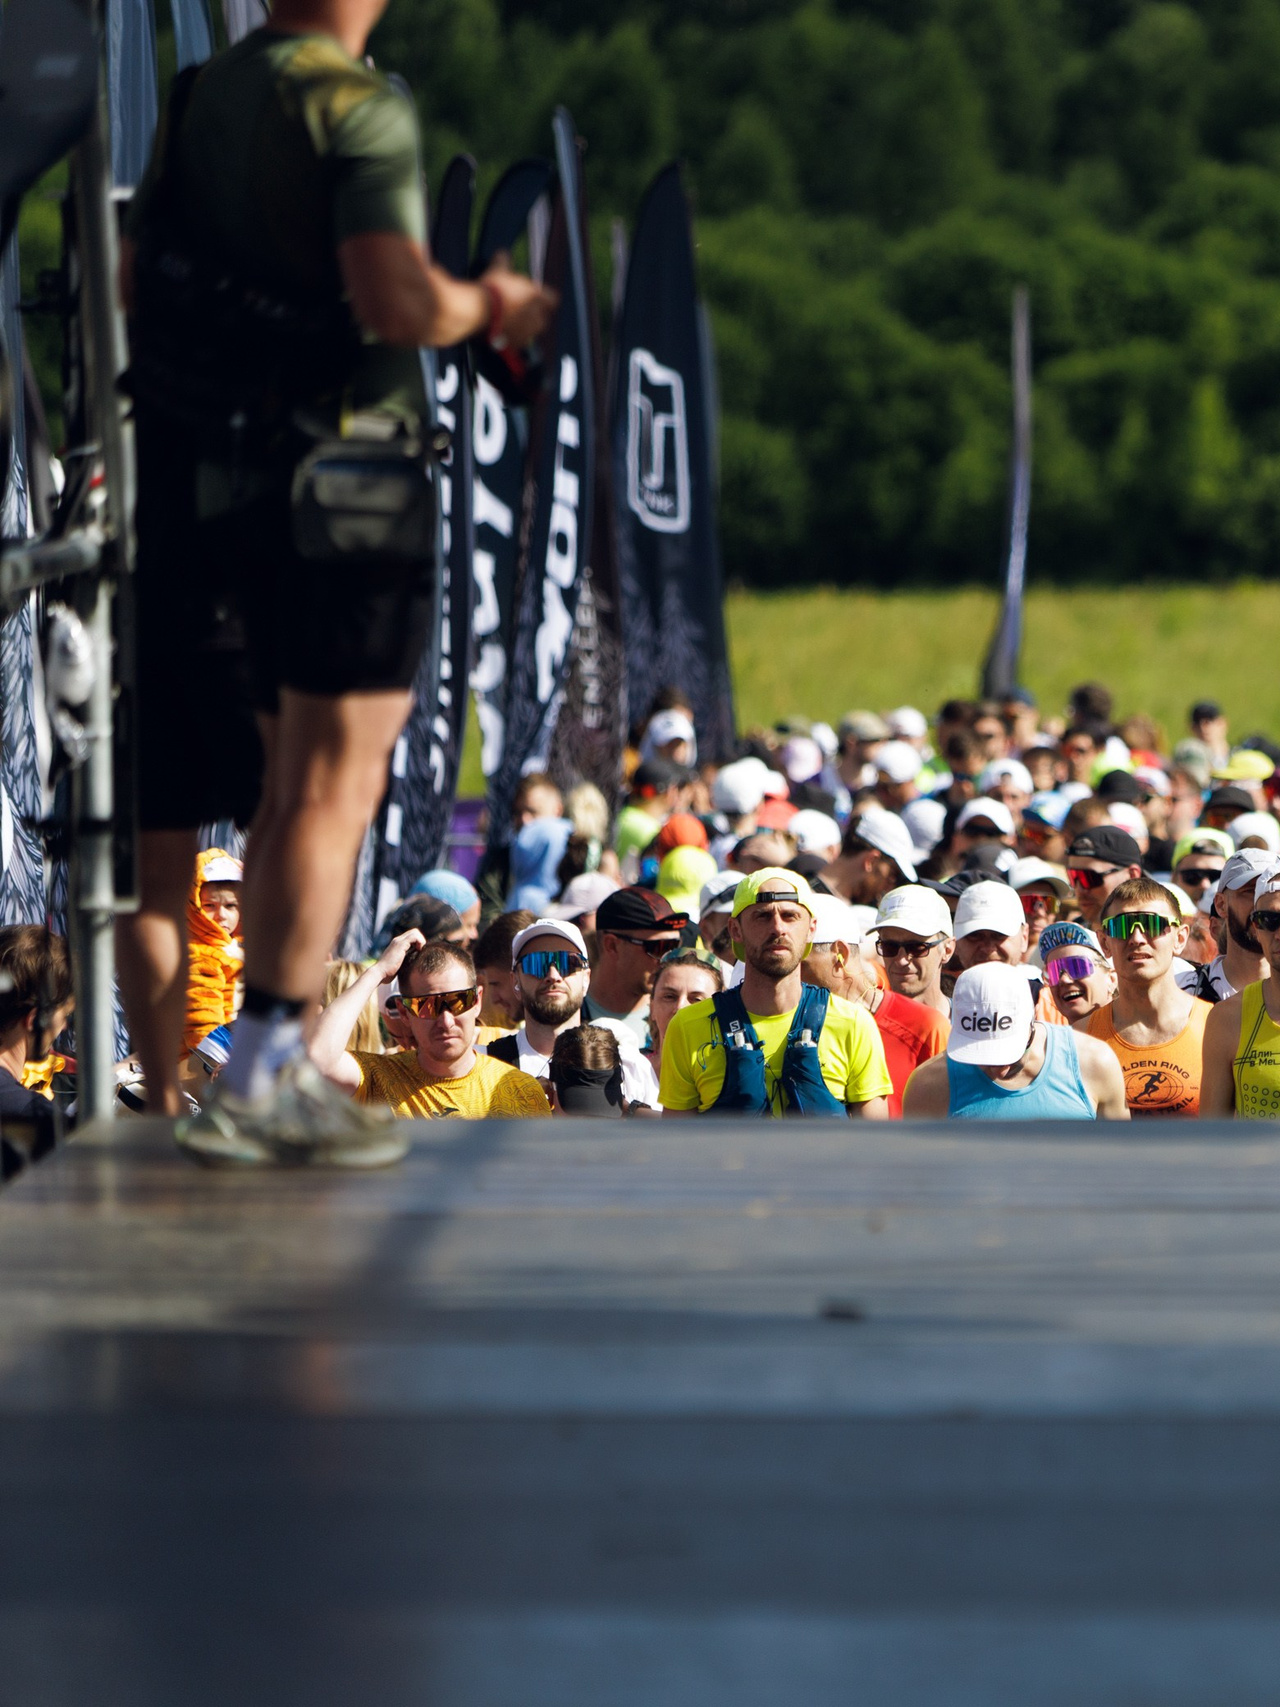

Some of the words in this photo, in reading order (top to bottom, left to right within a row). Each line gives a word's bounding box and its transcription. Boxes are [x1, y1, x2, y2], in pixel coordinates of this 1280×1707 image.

[961, 1012, 1013, 1033] ciele
[1122, 1060, 1158, 1073] LDEN
[1160, 1061, 1190, 1080] RING
